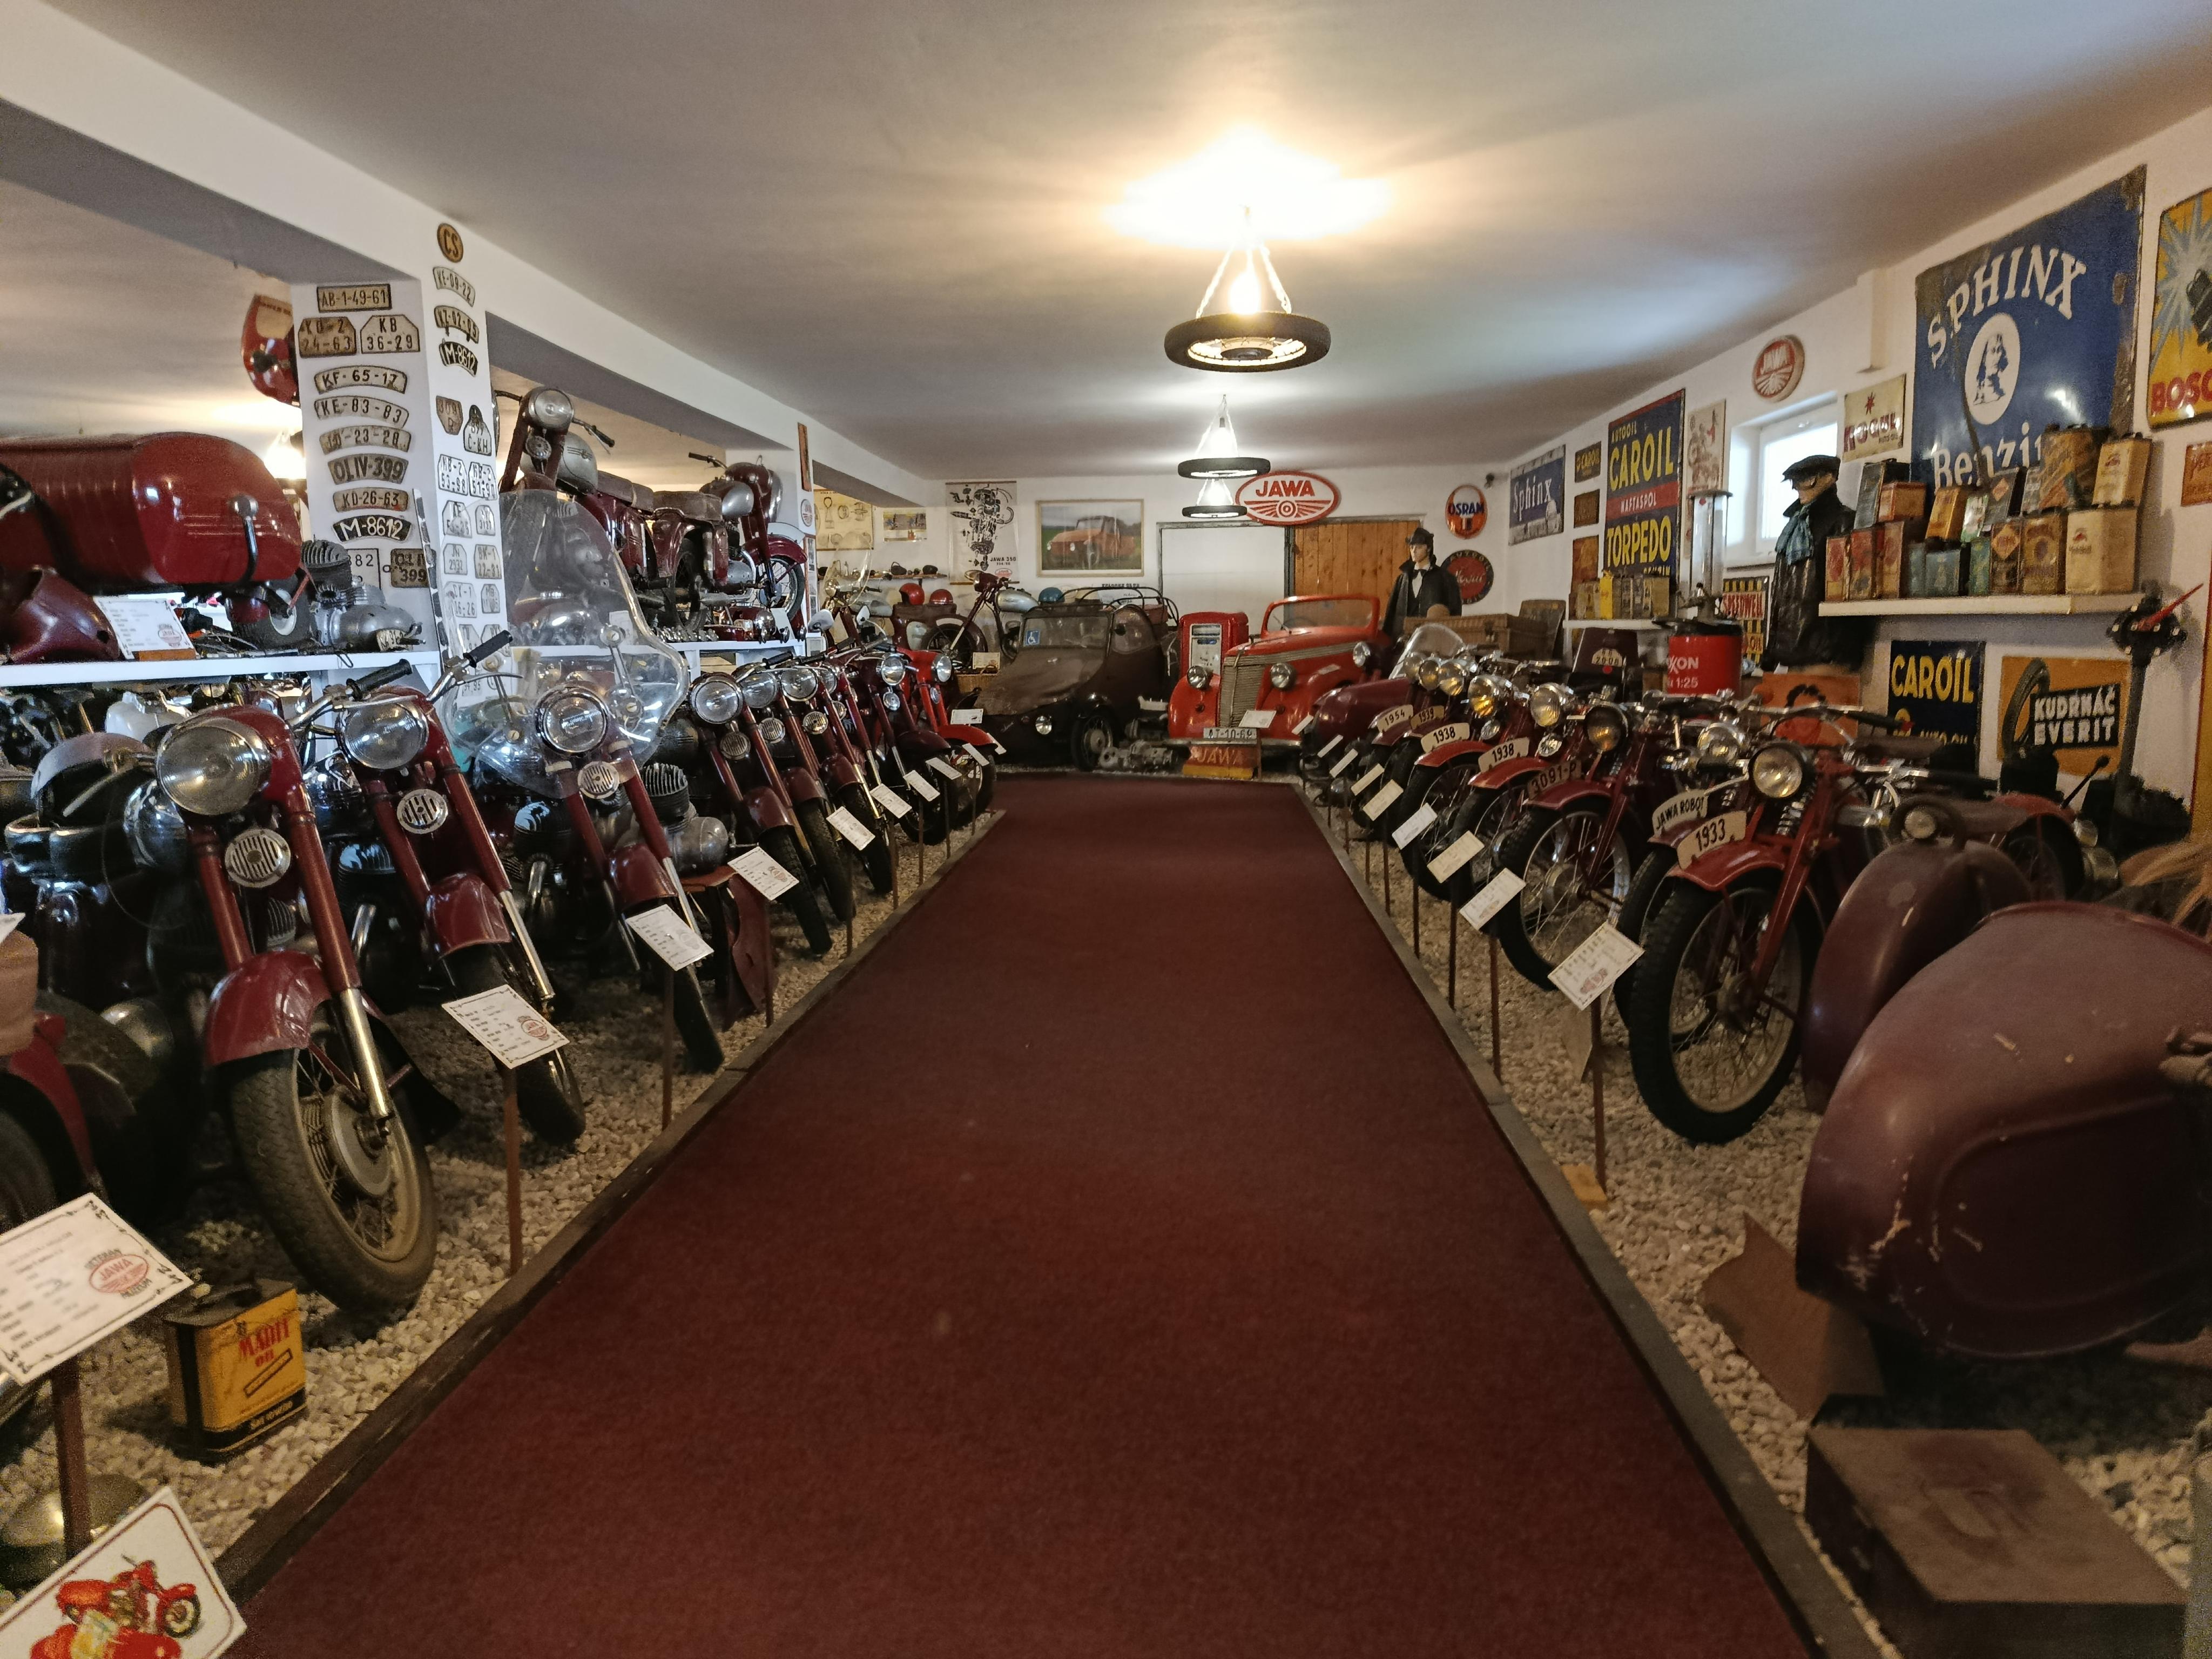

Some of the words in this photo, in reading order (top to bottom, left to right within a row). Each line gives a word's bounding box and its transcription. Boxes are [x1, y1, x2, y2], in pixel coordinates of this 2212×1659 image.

[443, 229, 459, 258] CS
[321, 289, 386, 307] AB-1-49-61
[1927, 244, 2087, 370] SPHINX
[379, 318, 397, 333] KB
[367, 334, 413, 350] 36-29
[321, 398, 402, 424] KE-83-83
[1609, 426, 1674, 491] CAROIL
[1256, 480, 1315, 497] JAWA
[1513, 475, 1552, 522] Sphinx
[1448, 502, 1485, 516] OSRAM
[340, 516, 403, 541] M-8612
[1606, 516, 1672, 568] TORPEDO
[1891, 653, 1974, 704] CAROIL
[1385, 709, 1405, 726] 1954
[1433, 727, 1456, 744] 1938
[2034, 716, 2115, 746] EVERIT
[1492, 743, 1514, 762] 1938
[1532, 762, 1576, 793] 3091-P
[1656, 804, 1678, 831] JAWA
[1696, 819, 1725, 852] 1933
